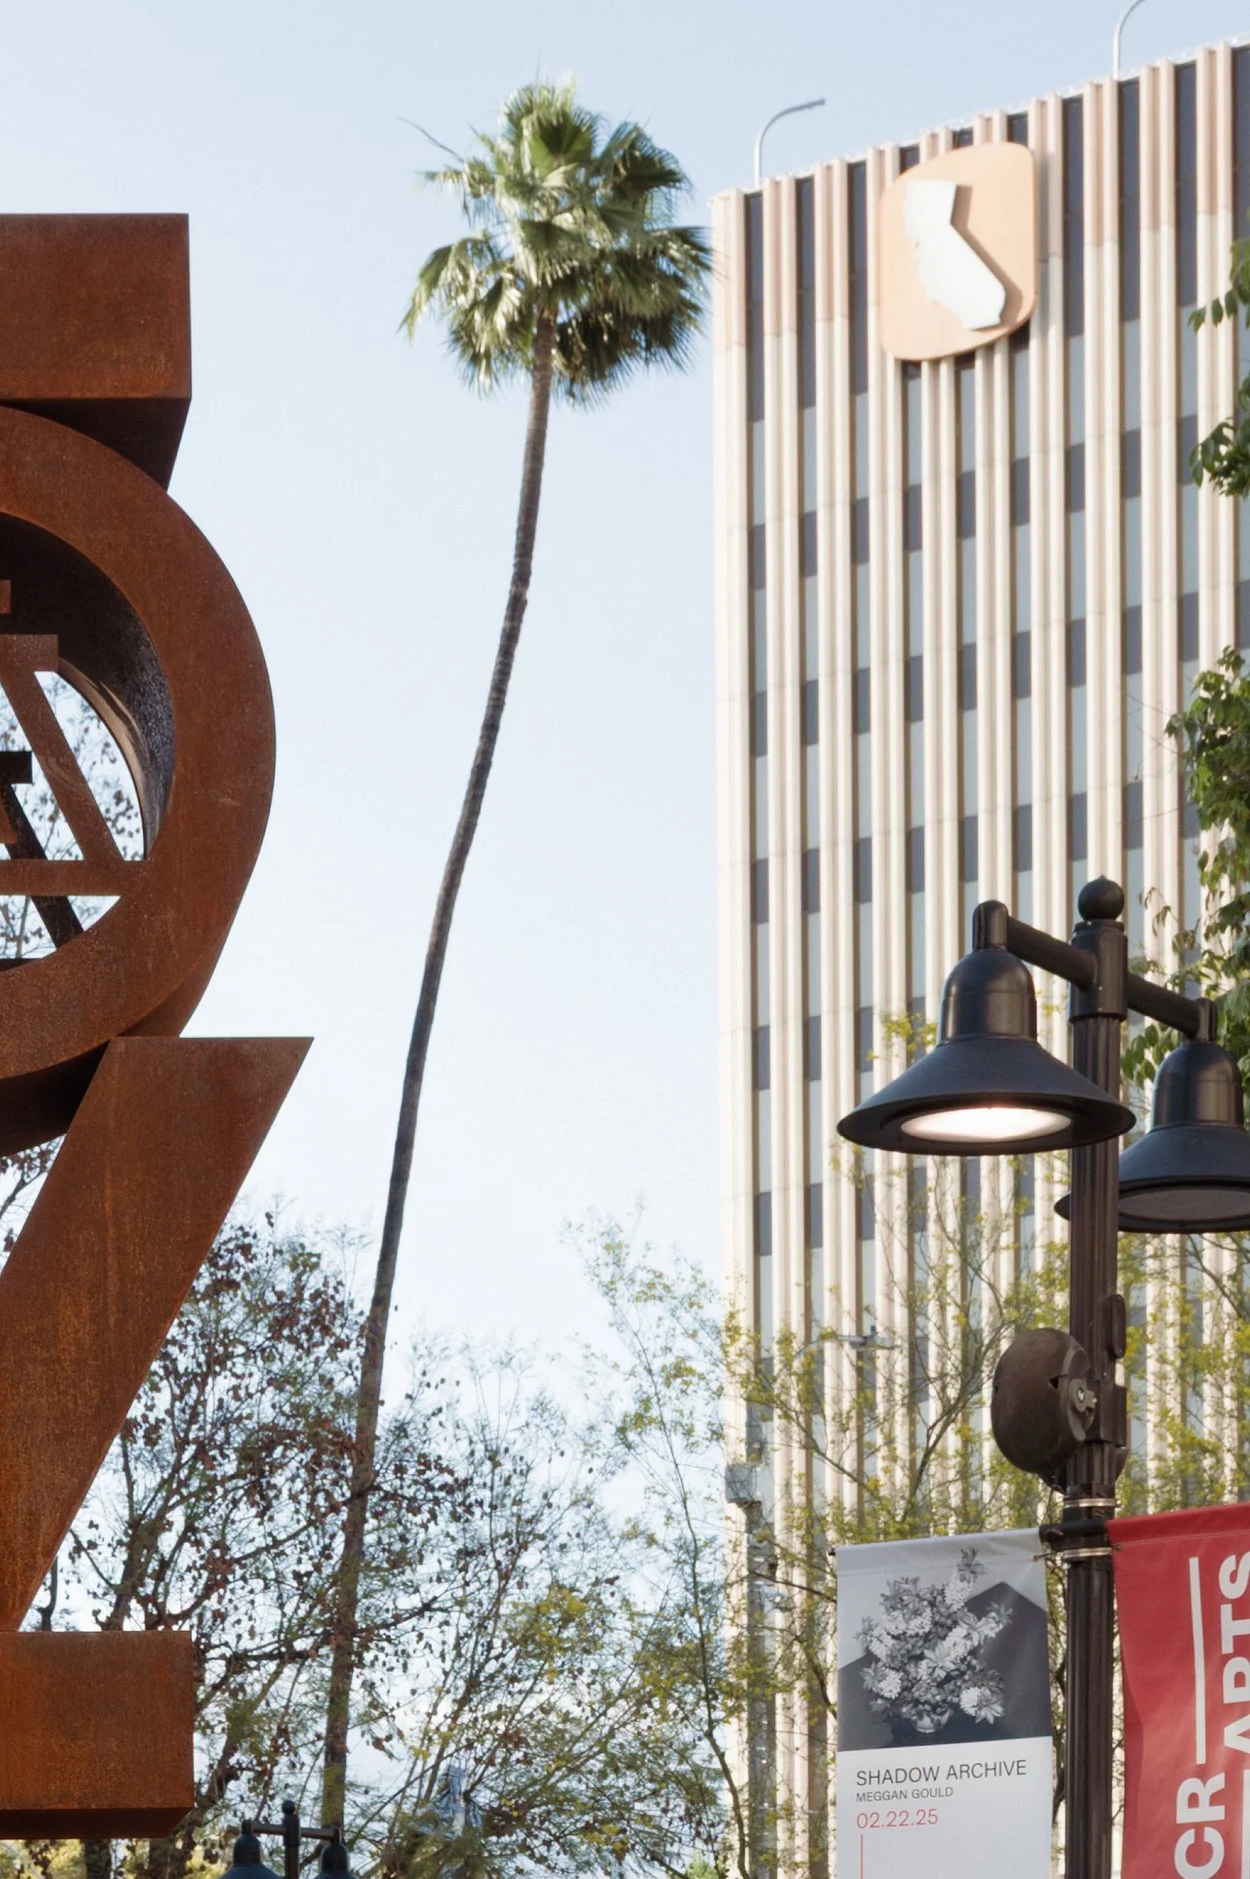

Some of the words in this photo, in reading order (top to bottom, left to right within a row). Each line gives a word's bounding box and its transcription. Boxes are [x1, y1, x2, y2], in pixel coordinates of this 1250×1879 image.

[856, 1765, 940, 1787] SHADOW
[945, 1759, 1027, 1781] ARCHIVE
[855, 1789, 908, 1803] MEGGAN
[911, 1786, 954, 1800] GOULD
[856, 1808, 939, 1829] 02.22.25
